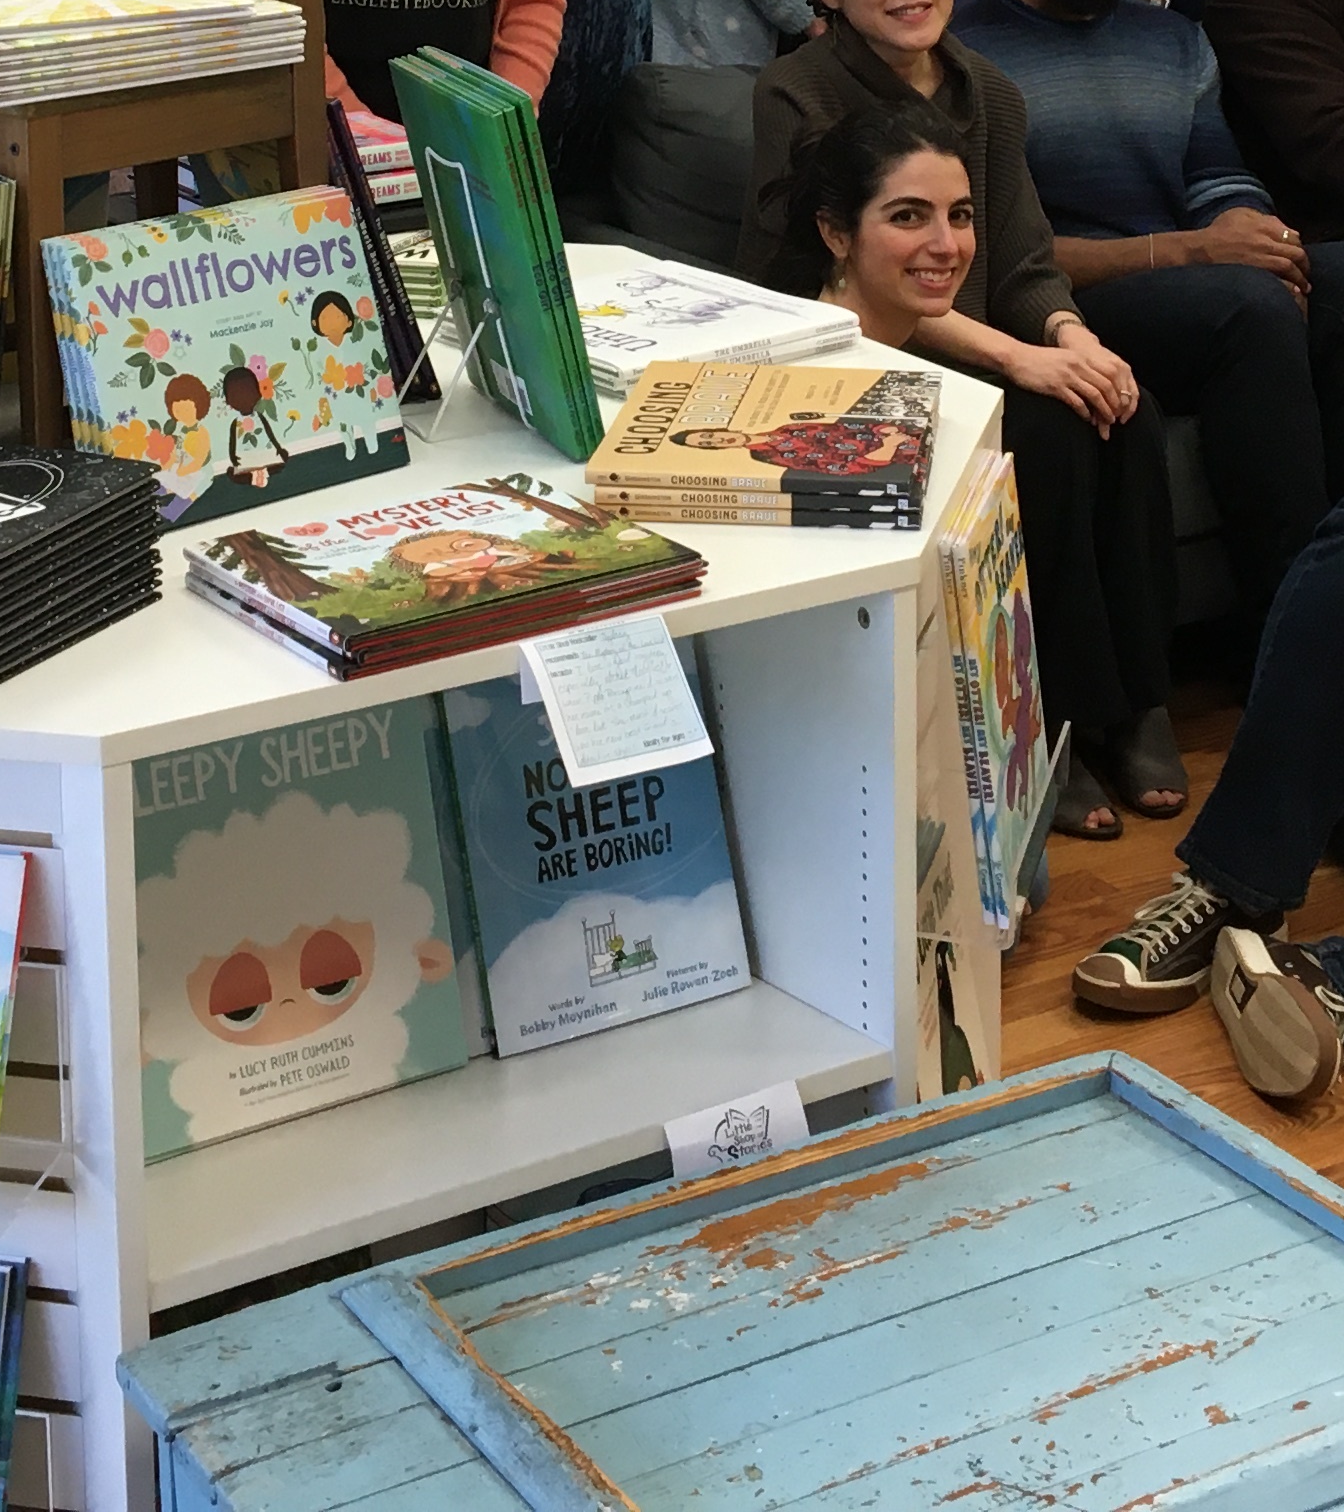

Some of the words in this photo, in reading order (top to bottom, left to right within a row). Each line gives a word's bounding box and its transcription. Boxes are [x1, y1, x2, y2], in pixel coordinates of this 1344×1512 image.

[95, 234, 357, 320] wallflowers
[208, 321, 256, 340] Mackenzie
[730, 338, 773, 357] UMBRELLA
[677, 368, 756, 427] BRAVE
[613, 381, 694, 455] CHOOSING
[670, 475, 729, 488] CHOOSING
[730, 477, 768, 489] BRAVE
[335, 491, 473, 530] MYSTERY
[439, 498, 506, 522] LIST
[680, 493, 739, 505] CHOOSING
[741, 494, 780, 506] BRAVE
[680, 509, 739, 521] CHOOSING
[741, 511, 779, 522] BRAVE
[260, 709, 395, 788] SHEEPY
[525, 775, 664, 853] SHEEP
[536, 845, 579, 884] ARE
[547, 998, 573, 1013] Words
[573, 995, 586, 1007] by
[641, 985, 670, 1004] Julie
[519, 1018, 556, 1038] Bobby
[557, 1000, 618, 1027] Moynihan
[238, 1059, 267, 1079] LUCY
[270, 1049, 299, 1069] RUTH
[301, 1034, 355, 1061] CUMMINS
[279, 1068, 304, 1087] PETE
[306, 1055, 351, 1079] OSWALD
[726, 1138, 774, 1160] Stories
